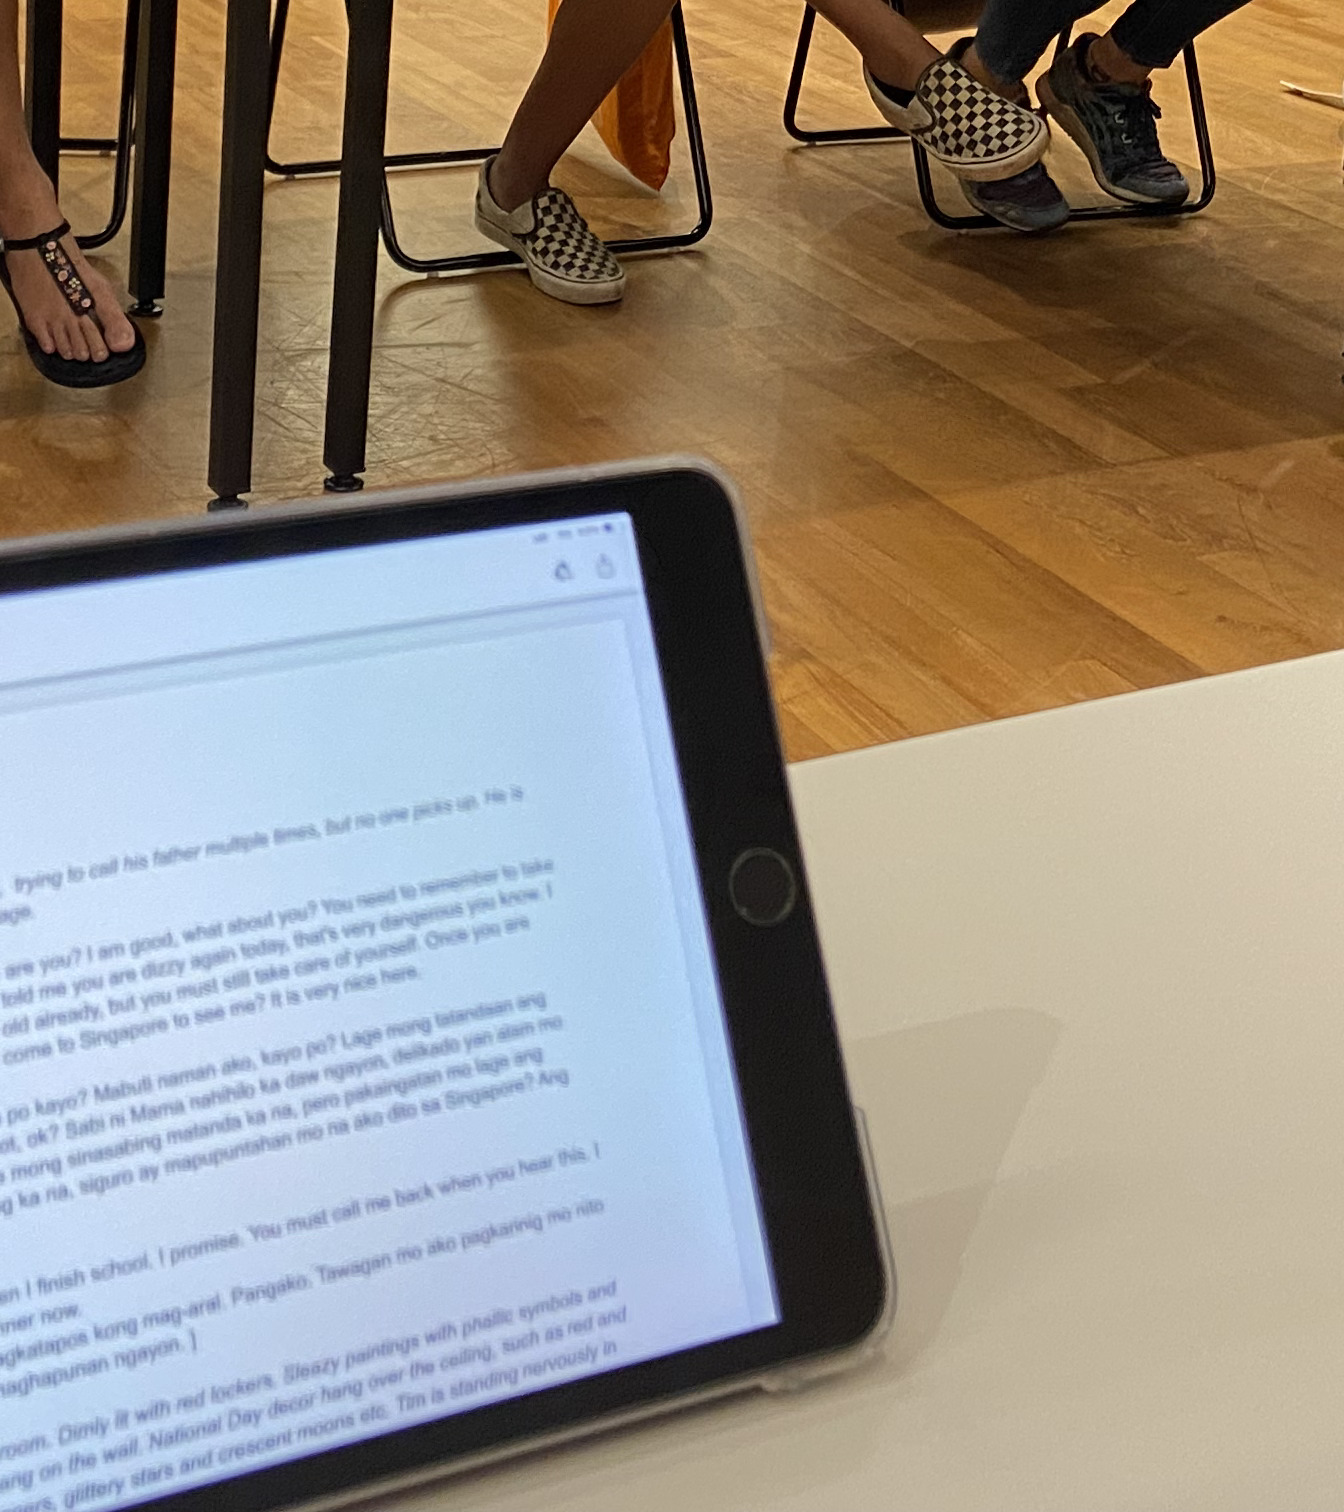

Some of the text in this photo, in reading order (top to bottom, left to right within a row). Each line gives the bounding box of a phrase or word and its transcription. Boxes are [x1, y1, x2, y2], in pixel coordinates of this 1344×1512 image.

[12, 870, 64, 896] trying
[66, 864, 85, 883] to
[88, 855, 119, 880] call
[122, 853, 149, 872] his
[151, 844, 201, 867] father
[204, 830, 269, 857] multiple
[0, 984, 35, 1009] told
[71, 973, 105, 999] you
[107, 966, 138, 988] are
[140, 957, 186, 981] dizzy
[189, 945, 237, 972] again
[340, 918, 377, 939] very
[378, 900, 464, 932] dangerous
[465, 895, 497, 919] you
[0, 1013, 30, 1038] old
[106, 993, 137, 1016] but
[139, 989, 173, 1014] you
[174, 975, 220, 1001] must
[221, 967, 252, 992] still
[253, 963, 291, 985] take
[293, 956, 331, 977] care
[423, 927, 469, 950] Once
[470, 922, 502, 945] you
[502, 914, 530, 935] are
[3, 960, 35, 980] are
[96, 941, 126, 961] am
[181, 920, 223, 943] what
[226, 909, 275, 935] about
[1, 1040, 54, 1066] come
[78, 1016, 169, 1051] Singapore
[192, 1004, 226, 1025] see
[303, 981, 340, 1001] very
[342, 972, 378, 994] nice
[35, 1267, 86, 1296] finish
[248, 1222, 283, 1242] You
[284, 1207, 329, 1235] must
[330, 1198, 361, 1224] call
[392, 1181, 435, 1207] back
[436, 1172, 483, 1196] when
[484, 1164, 516, 1190] you
[516, 1154, 554, 1177] hear
[57, 1415, 110, 1447] Dimly
[113, 1408, 130, 1430] lit
[133, 1398, 171, 1424] with
[175, 1386, 206, 1414] red
[282, 1355, 340, 1385] Sleazy
[343, 1333, 420, 1373] paintings
[423, 1320, 458, 1346] with
[460, 1306, 514, 1341] phallic
[517, 1288, 583, 1323] symbols
[586, 1277, 617, 1302] and
[66, 1450, 98, 1475] the
[146, 1414, 223, 1452] National
[226, 1406, 263, 1432] Day
[266, 1391, 316, 1420] decor
[318, 1378, 364, 1404] hang
[366, 1367, 404, 1393] over
[408, 1359, 436, 1381] the
[500, 1327, 540, 1355] such
[565, 1313, 594, 1336] red
[596, 1303, 627, 1329] and
